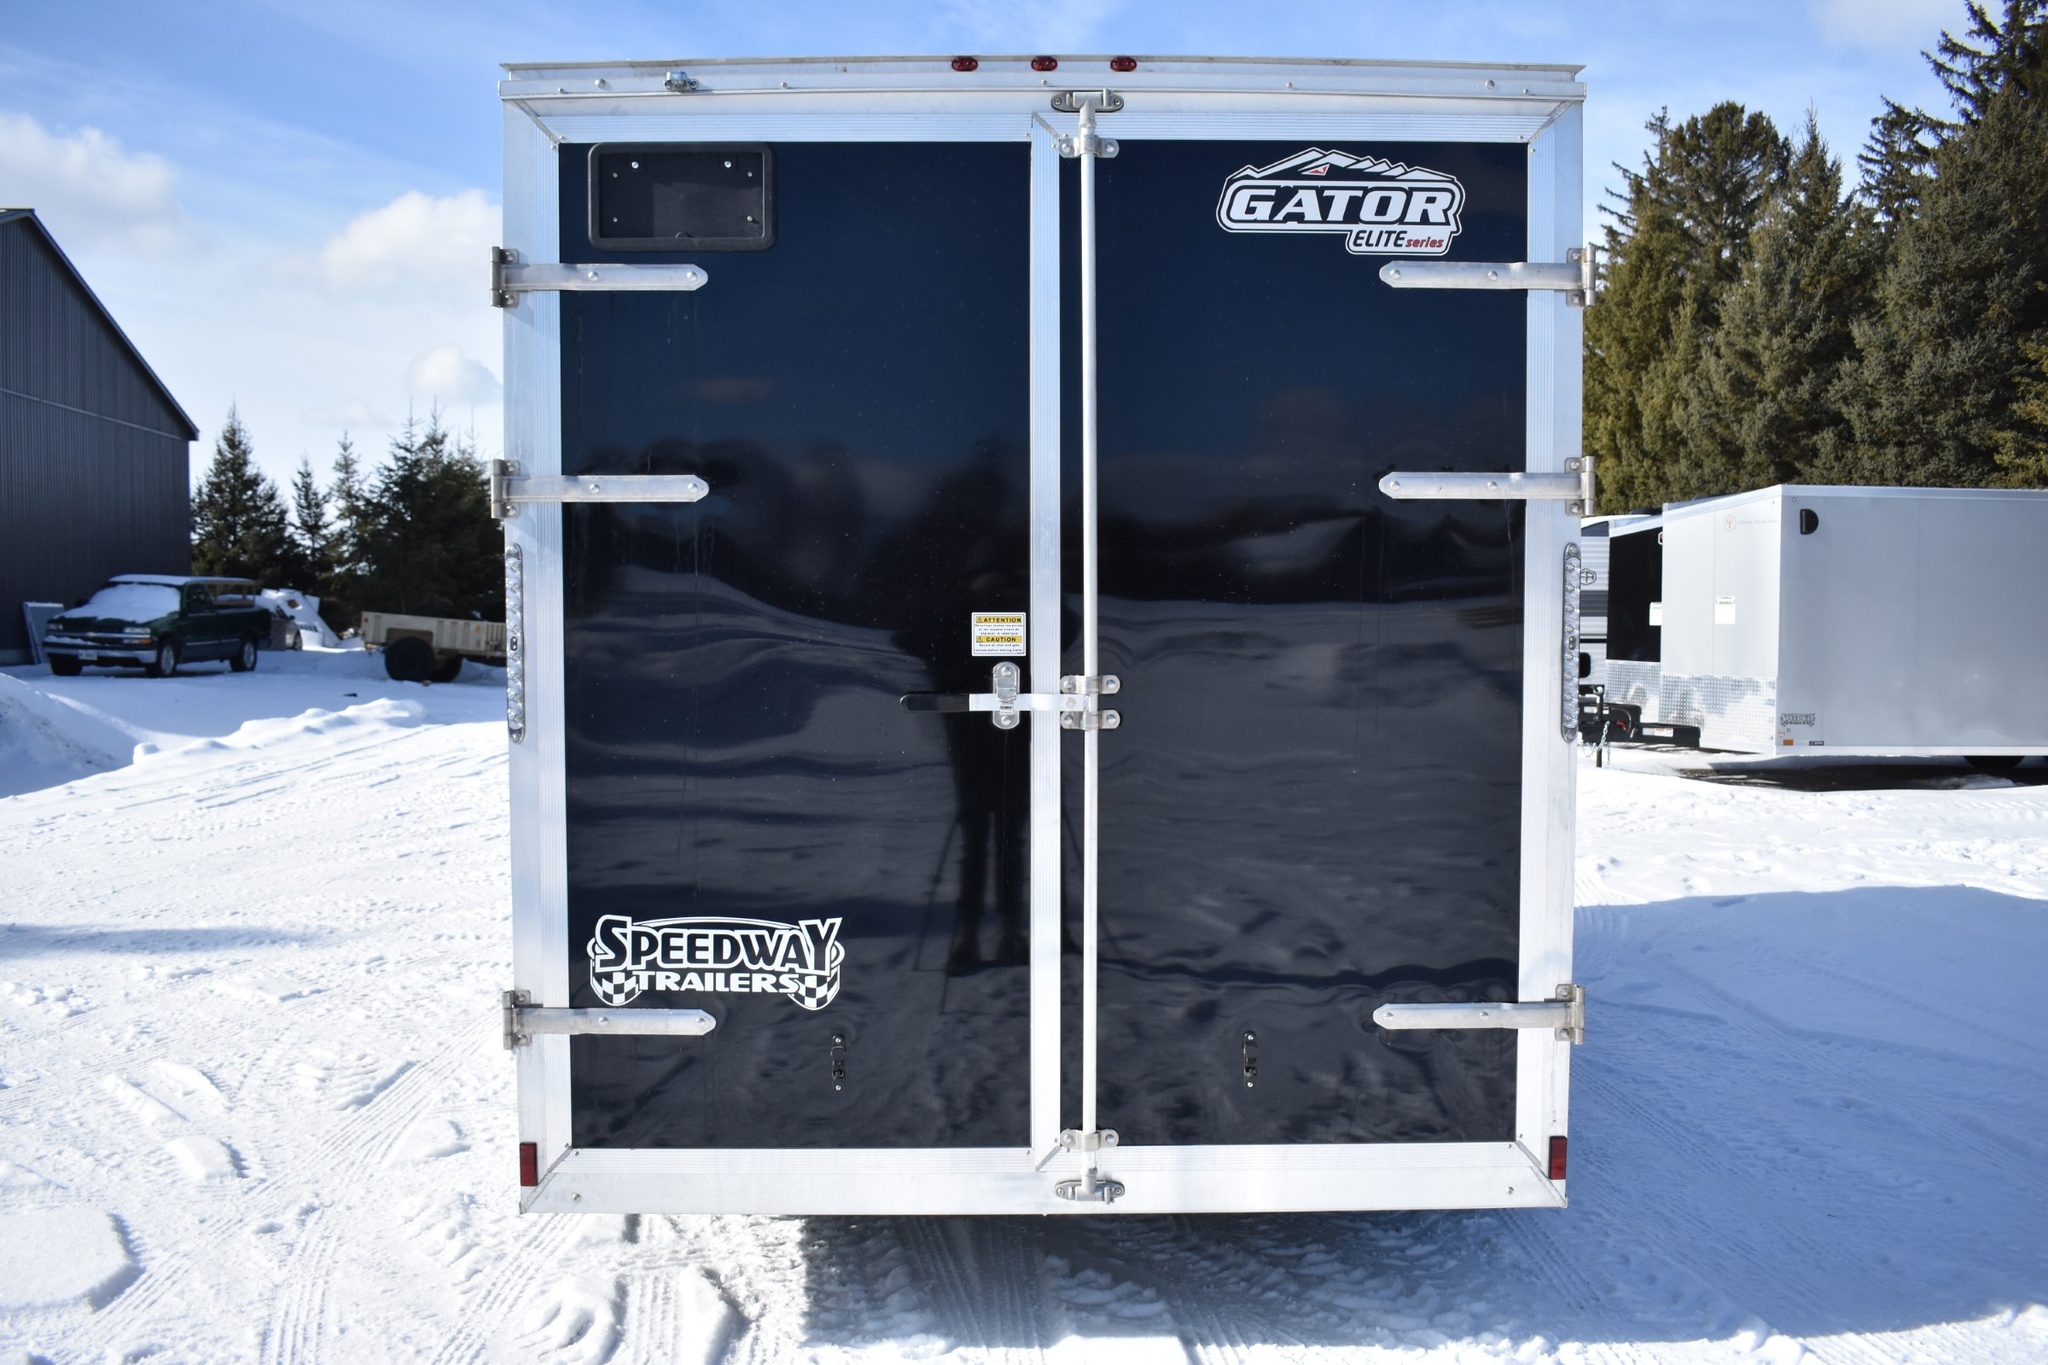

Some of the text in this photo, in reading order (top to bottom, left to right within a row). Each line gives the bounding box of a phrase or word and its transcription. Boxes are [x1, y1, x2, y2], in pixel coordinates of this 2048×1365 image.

[1229, 188, 1452, 223] GATOR
[1352, 229, 1445, 249] ELITE series
[595, 914, 843, 977] SPEEDWAY
[632, 970, 802, 993] TRAILERS
